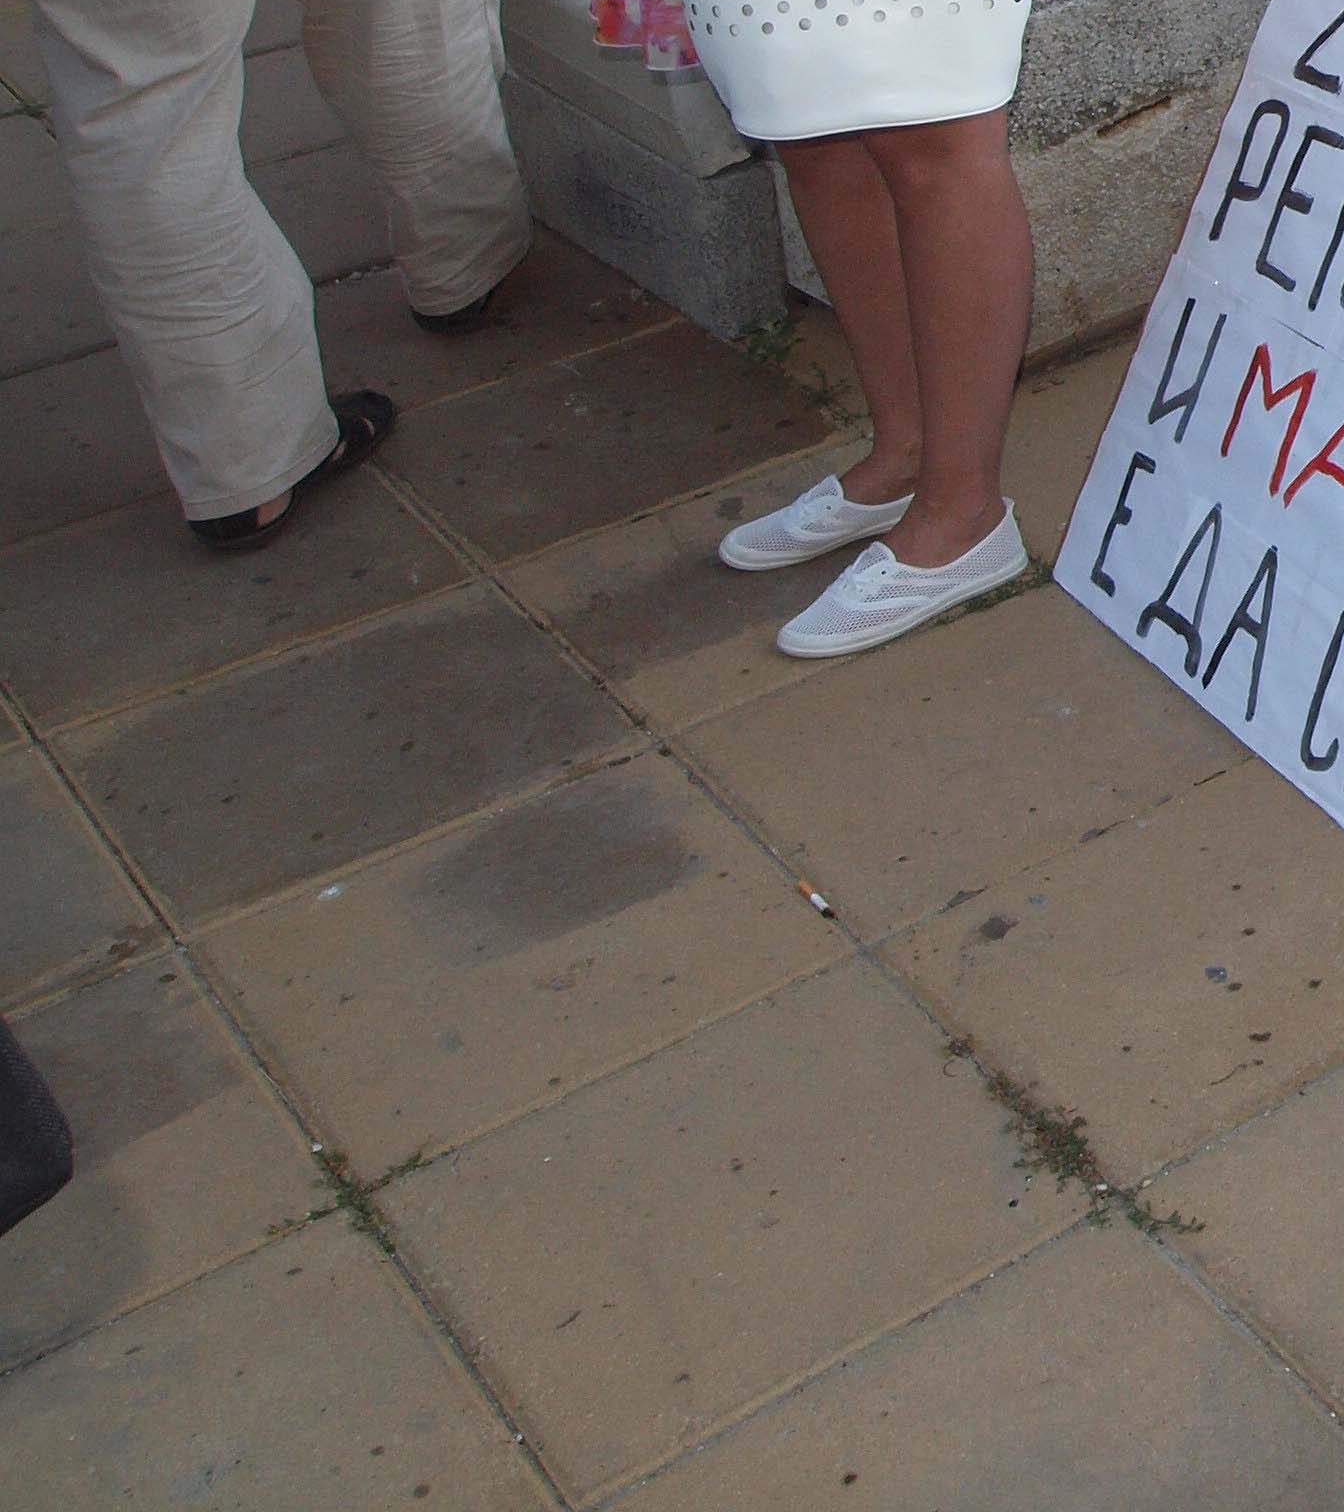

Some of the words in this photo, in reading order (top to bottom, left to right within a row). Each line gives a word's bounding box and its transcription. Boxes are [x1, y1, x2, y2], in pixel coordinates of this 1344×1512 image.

[1147, 297, 1228, 444] И
[1090, 450, 1157, 598] Е
[1136, 502, 1279, 723] ДА
